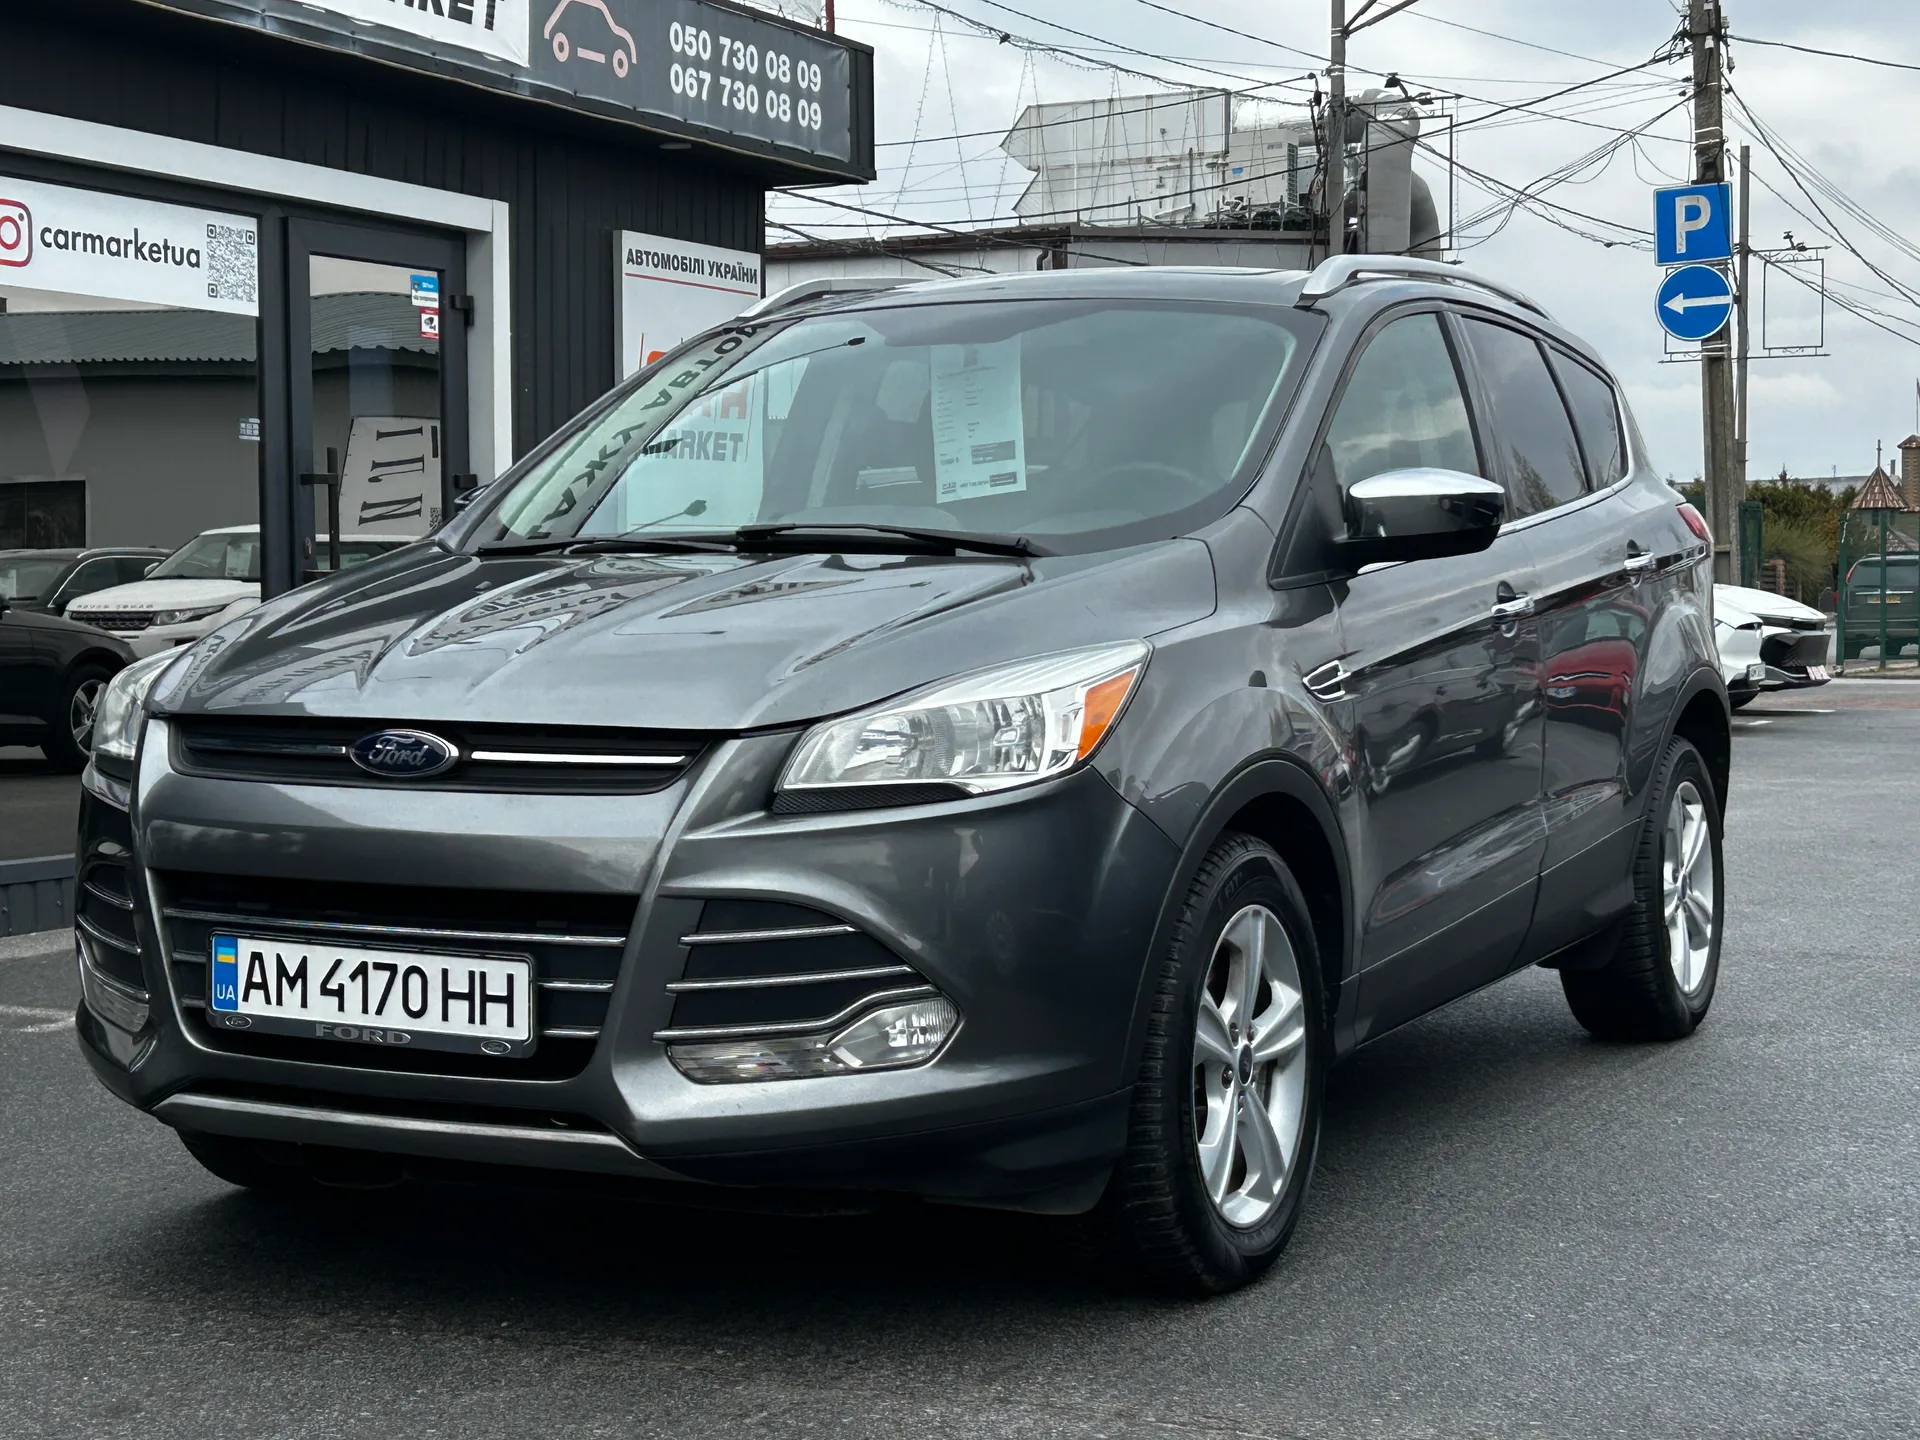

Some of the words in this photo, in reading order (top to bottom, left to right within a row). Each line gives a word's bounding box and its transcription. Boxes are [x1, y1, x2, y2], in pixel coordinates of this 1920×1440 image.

[669, 21, 711, 61] 050
[719, 35, 759, 75] 730
[765, 50, 791, 84] 08
[797, 60, 822, 92] 09
[670, 63, 711, 101] 067
[719, 76, 759, 114] 730
[765, 89, 791, 123] 08
[797, 99, 822, 130] 09
[1675, 194, 1711, 254] P
[40, 226, 200, 268] carmarketua
[626, 248, 705, 275] АВТОМОБІЛІ
[708, 260, 758, 284] УКРАЇНИ
[368, 735, 429, 766] Ford
[216, 983, 236, 1001] UA
[241, 951, 308, 1009] AM
[319, 958, 429, 1019] 4170
[441, 967, 515, 1028] HH
[315, 1023, 411, 1045] FORD
